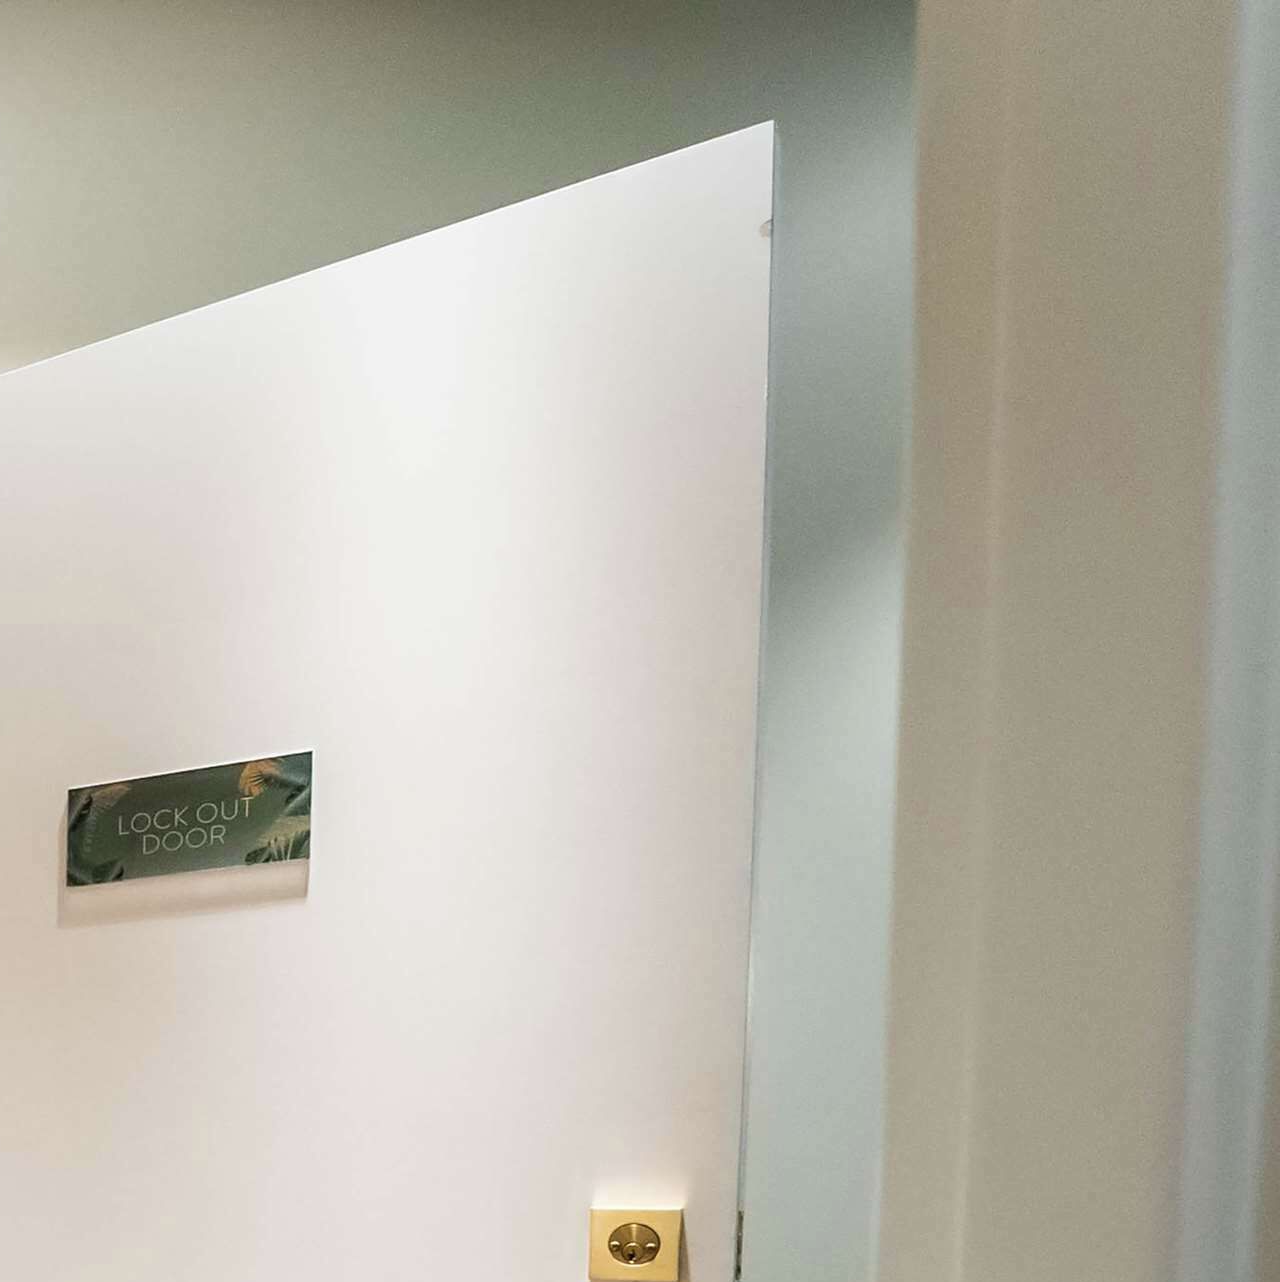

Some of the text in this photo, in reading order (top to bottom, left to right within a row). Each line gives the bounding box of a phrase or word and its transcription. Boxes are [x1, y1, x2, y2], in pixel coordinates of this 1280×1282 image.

[118, 796, 254, 836] LOCK OUT
[142, 824, 226, 855] DOOR
